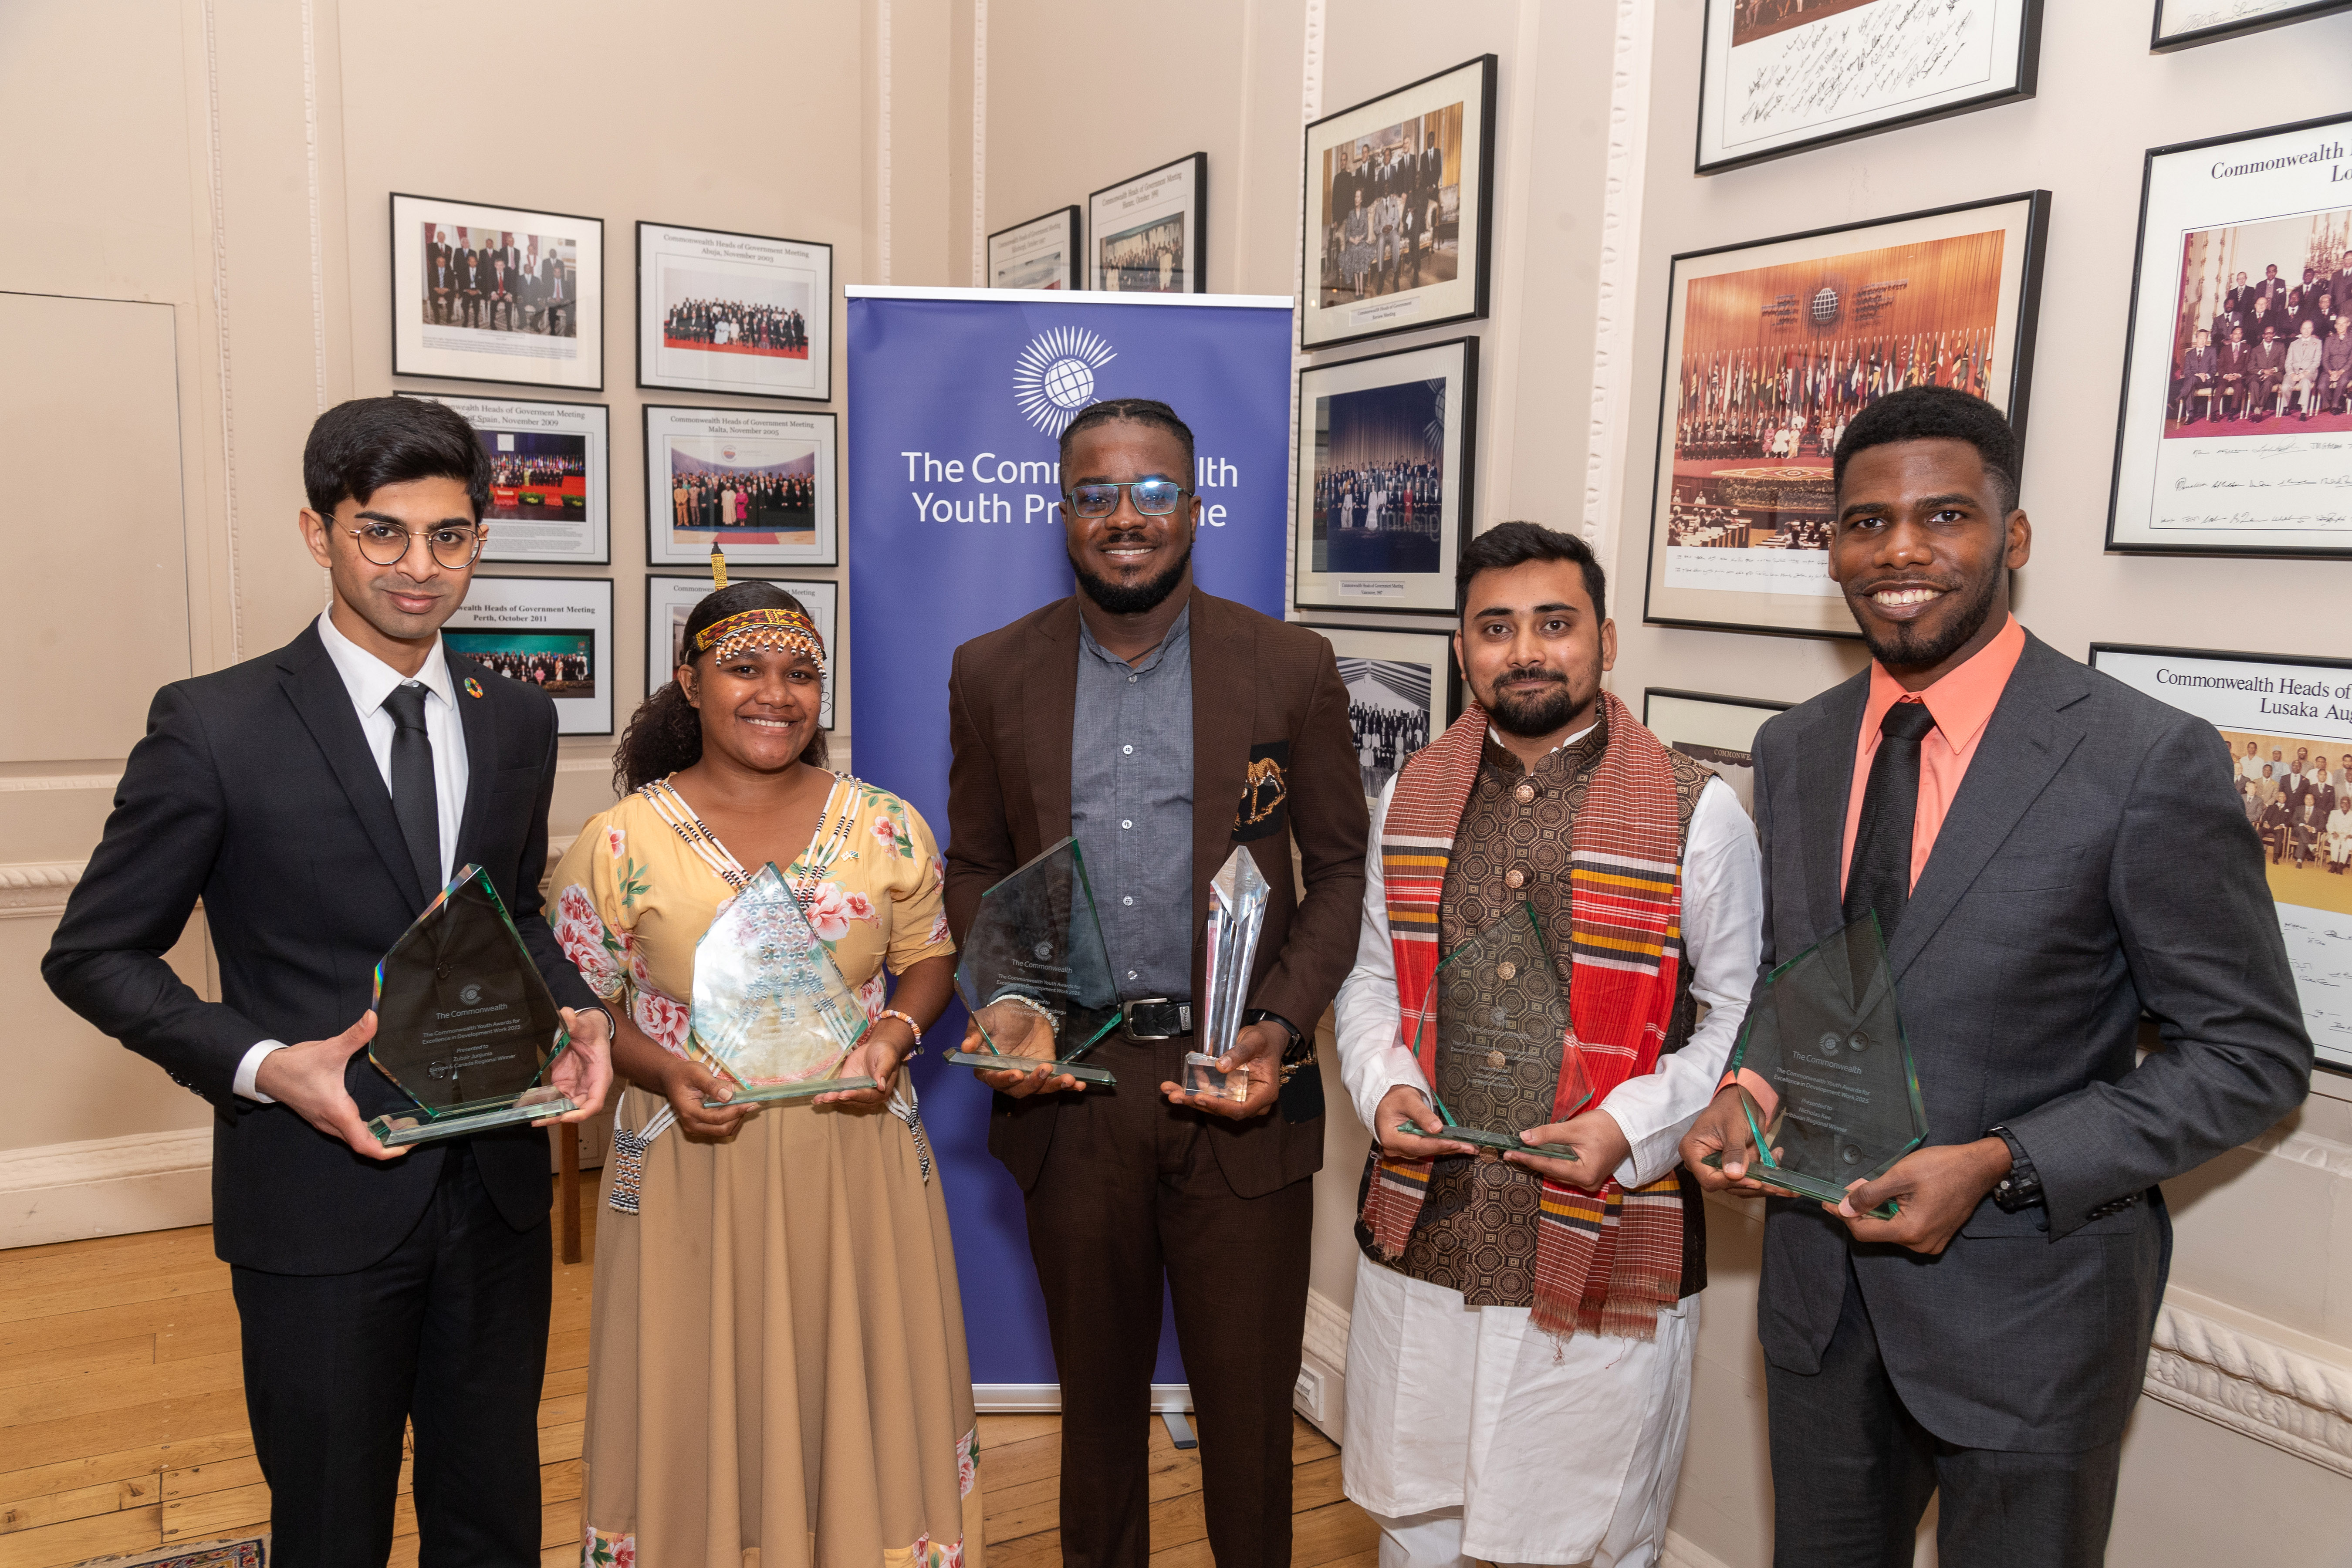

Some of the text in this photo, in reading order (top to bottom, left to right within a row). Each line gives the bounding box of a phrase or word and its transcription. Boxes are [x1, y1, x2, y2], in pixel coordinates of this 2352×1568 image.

[2211, 142, 2344, 179] Commonwealth
[664, 234, 714, 247] Commonwealth
[716, 240, 736, 249] Heads
[744, 244, 783, 255] Government
[784, 249, 809, 258] Meeting
[701, 247, 722, 257] Abuja,
[723, 250, 755, 260] November
[482, 404, 504, 413] Heads
[557, 409, 585, 419] Meeting
[477, 415, 500, 424] Spain,
[502, 416, 538, 426] November
[671, 416, 720, 424] Commonwealth
[750, 419, 788, 427] Government
[901, 452, 964, 483] The
[912, 492, 1011, 523] Youth
[566, 606, 595, 614] Meeting
[2156, 669, 2352, 699] Commonwealth Heads of
[2260, 698, 2319, 718] Lusaka
[1714, 749, 1752, 760] COMMONWE
[1024, 961, 1073, 973] Commonwealth
[1007, 975, 1043, 984] Commonwealth
[1025, 983, 1056, 993] Development
[451, 1003, 507, 1017] Commonwealth
[422, 1036, 451, 1044] Excellence
[457, 1029, 493, 1039] Development
[434, 1025, 476, 1036] Commonwealth
[1479, 1027, 1530, 1040] Commonwealth
[456, 1045, 483, 1053] Presented
[474, 1057, 497, 1065] Regional
[1792, 1051, 1862, 1075] The Commonwealth
[1774, 1074, 1800, 1086] Excellence
[1805, 1082, 1841, 1097] Development
[1841, 1092, 1855, 1100] Work
[1786, 1070, 1826, 1085] Commonwealth
[1827, 1080, 1842, 1089] Youth
[1842, 1084, 1862, 1094] Awards
[1801, 1098, 1826, 1109] Presented
[1798, 1107, 1821, 1118] Nicholas
[1806, 1117, 1828, 1128] Regional
[1829, 1123, 1848, 1133] Winner
